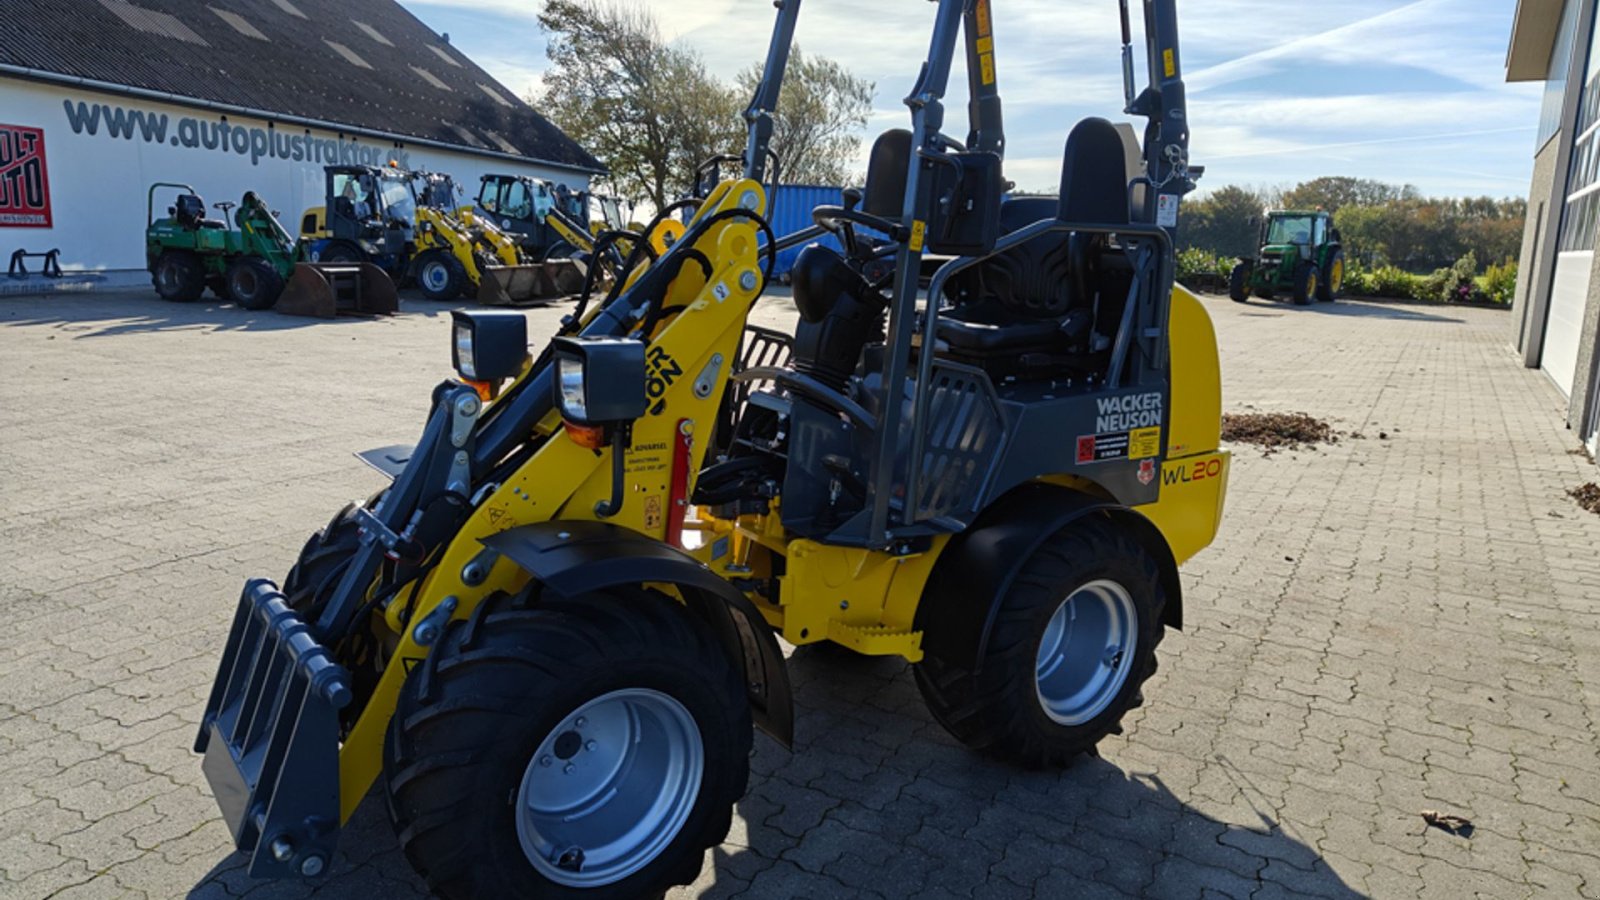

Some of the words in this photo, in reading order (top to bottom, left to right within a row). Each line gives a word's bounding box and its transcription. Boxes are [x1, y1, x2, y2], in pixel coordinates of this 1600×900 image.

[1096, 392, 1162, 415] WACKER
[1096, 409, 1162, 433] NEUSON
[1163, 458, 1221, 486] WL20
